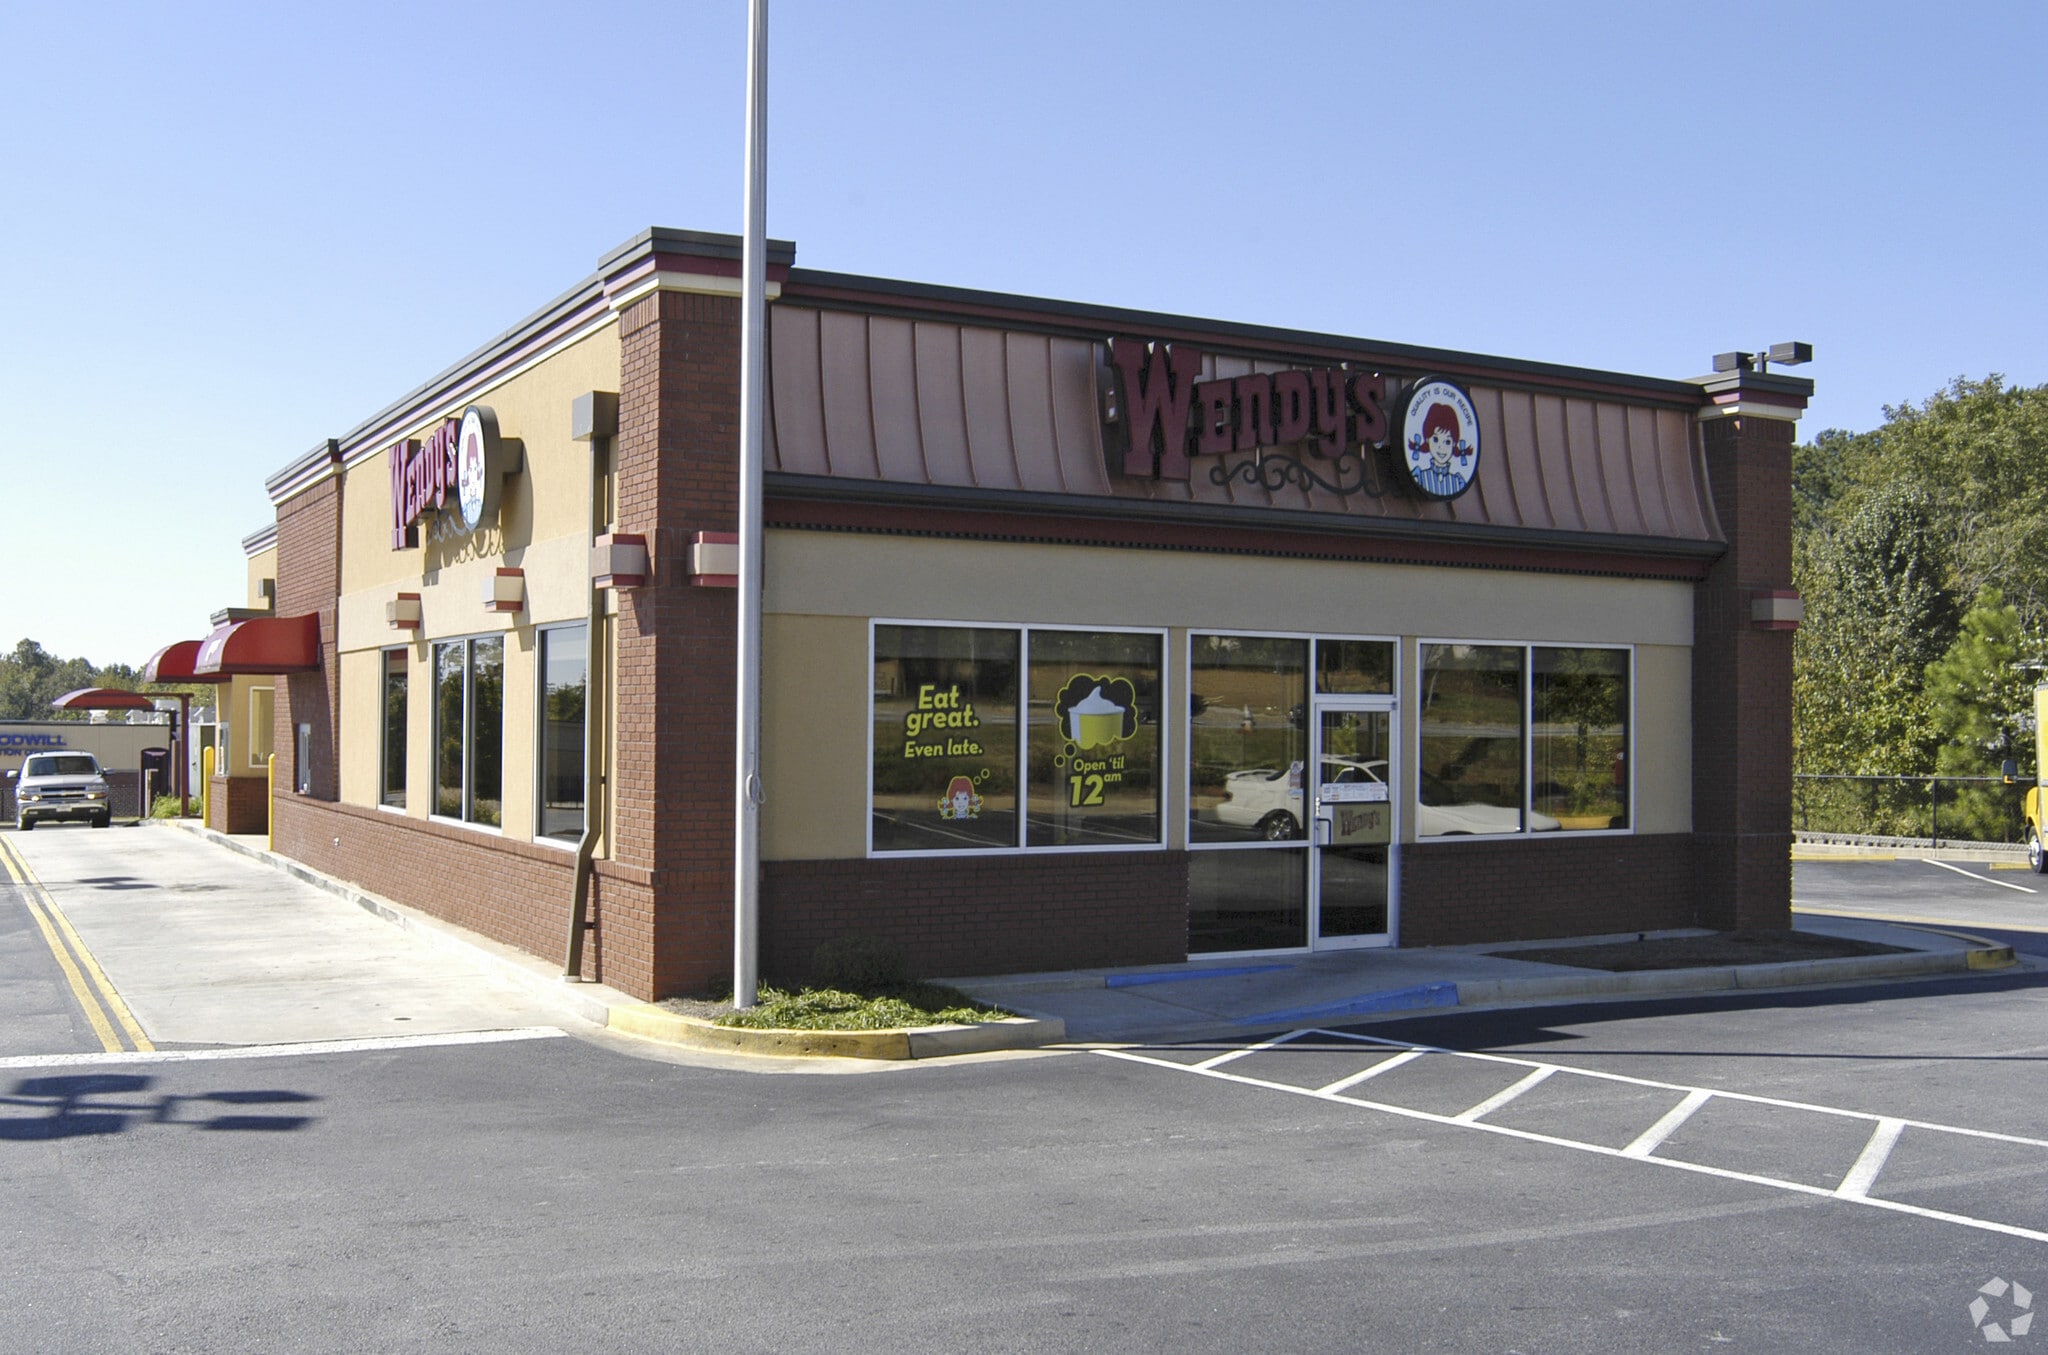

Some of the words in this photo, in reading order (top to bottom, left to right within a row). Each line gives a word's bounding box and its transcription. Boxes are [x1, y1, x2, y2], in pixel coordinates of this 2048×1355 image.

[1411, 391, 1431, 416] QUALITY
[1434, 387, 1440, 395] IS
[1443, 388, 1456, 400] OUR
[1457, 398, 1473, 426] RECIPE
[918, 685, 960, 710] Eat
[906, 704, 979, 737] great.
[904, 741, 944, 758] Even
[947, 738, 983, 756] late.
[1073, 758, 1106, 774] Open
[1070, 774, 1104, 806] 12
[1103, 773, 1122, 782] am
